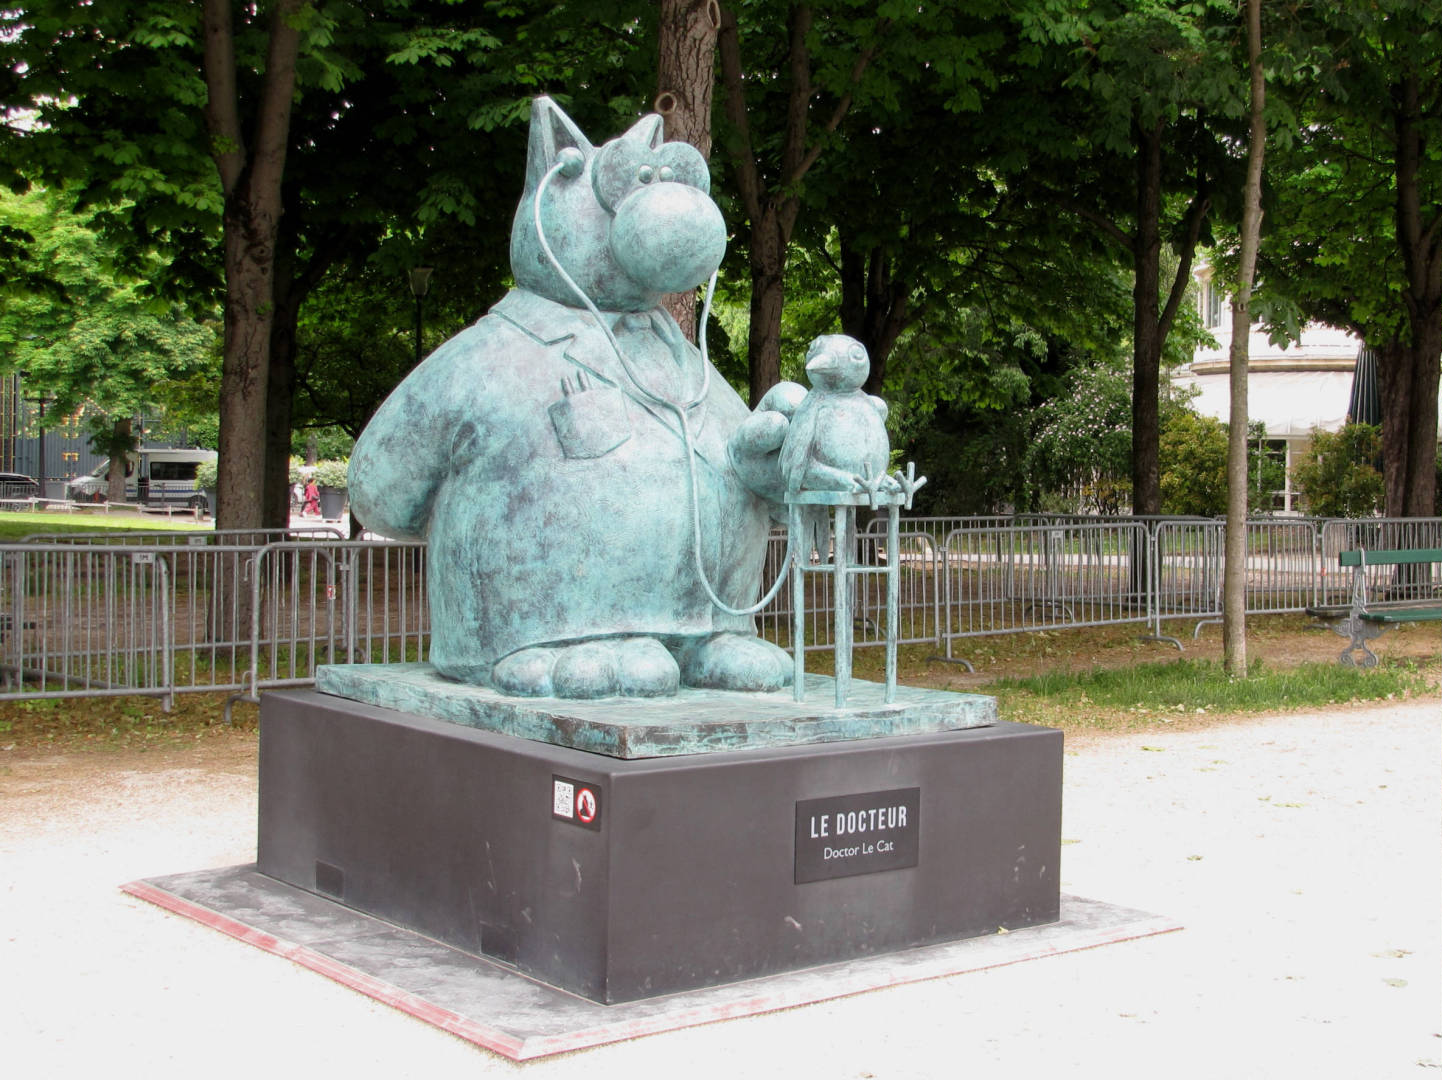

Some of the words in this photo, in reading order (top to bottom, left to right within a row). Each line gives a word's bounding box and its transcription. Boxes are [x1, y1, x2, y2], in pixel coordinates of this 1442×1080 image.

[811, 815, 829, 838] LE
[836, 806, 907, 835] DOCTEUR
[824, 847, 860, 860] Doctor
[862, 842, 874, 854] Le
[877, 840, 894, 852] Cat
